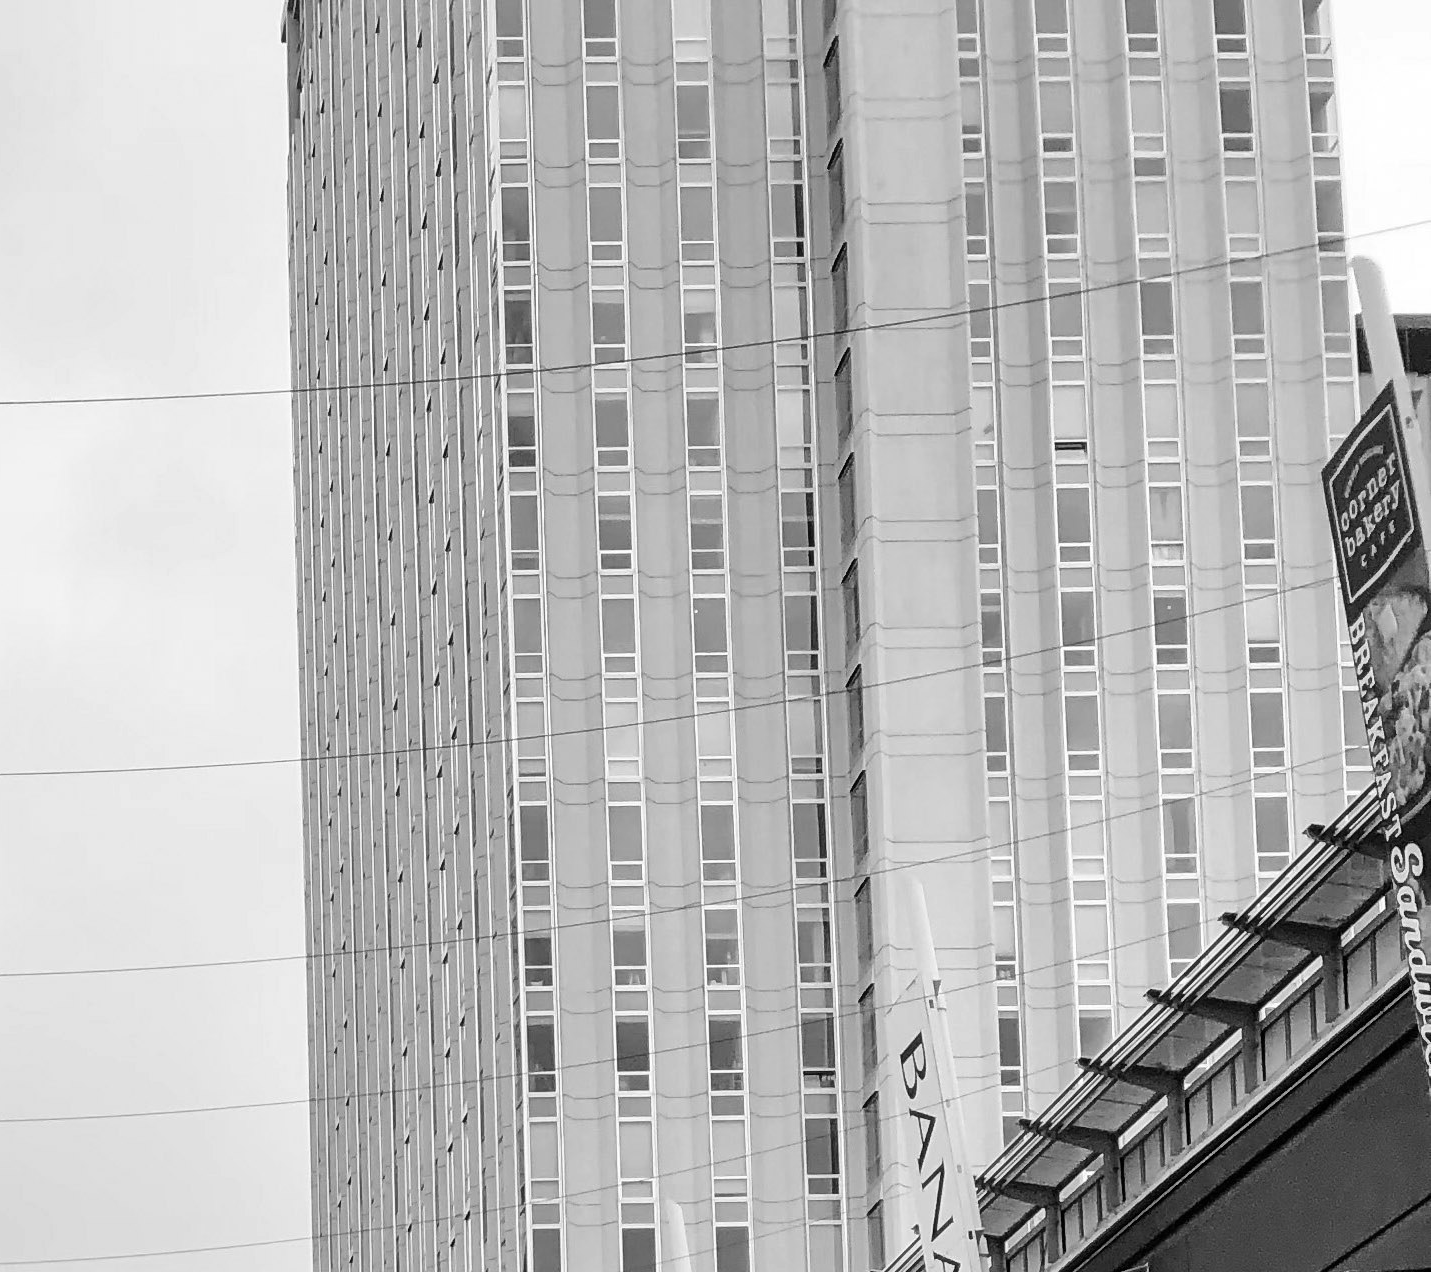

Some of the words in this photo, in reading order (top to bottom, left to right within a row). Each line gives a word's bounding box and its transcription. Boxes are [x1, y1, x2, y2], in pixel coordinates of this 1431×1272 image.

[1341, 452, 1396, 532] corner
[1345, 480, 1400, 557] bakery
[1349, 611, 1403, 843] BREAKFAST
